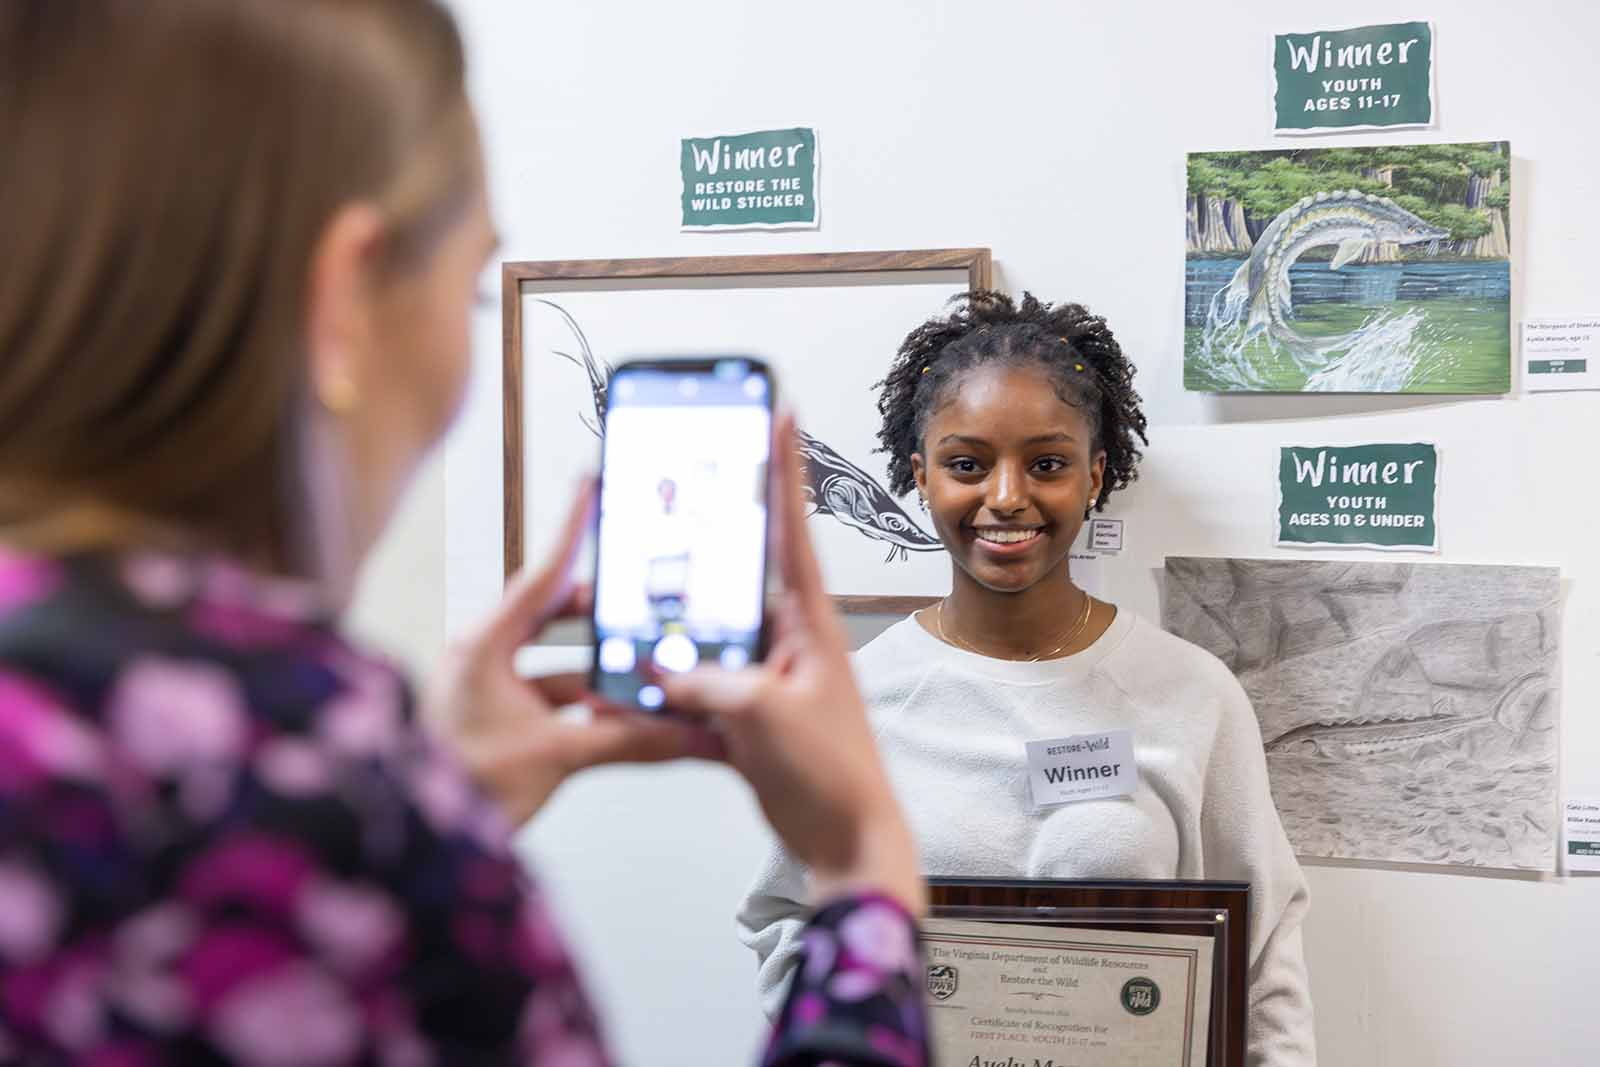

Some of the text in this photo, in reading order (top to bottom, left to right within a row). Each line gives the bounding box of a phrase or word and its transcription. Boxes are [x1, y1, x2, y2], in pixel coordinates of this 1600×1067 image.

[1286, 35, 1419, 73] Winner
[1322, 77, 1382, 93] YOUTH
[1304, 94, 1401, 112] AGES 11-17
[691, 139, 804, 175] Winner
[695, 177, 801, 195] RESTORE THE
[691, 193, 805, 211] WILD STICKER
[1292, 450, 1424, 487] Winner
[1327, 496, 1387, 509] YOUTH
[1289, 513, 1425, 527] AGES 10 & UNDER
[1044, 763, 1120, 784] Winner
[932, 947, 1149, 969] The Virginia Department of Wildlife Resources
[1000, 974, 1079, 988] Restore the Wild
[971, 1016, 1020, 1028] Certificate
[1022, 1019, 1033, 1028] of
[1035, 1021, 1092, 1033] Recognition
